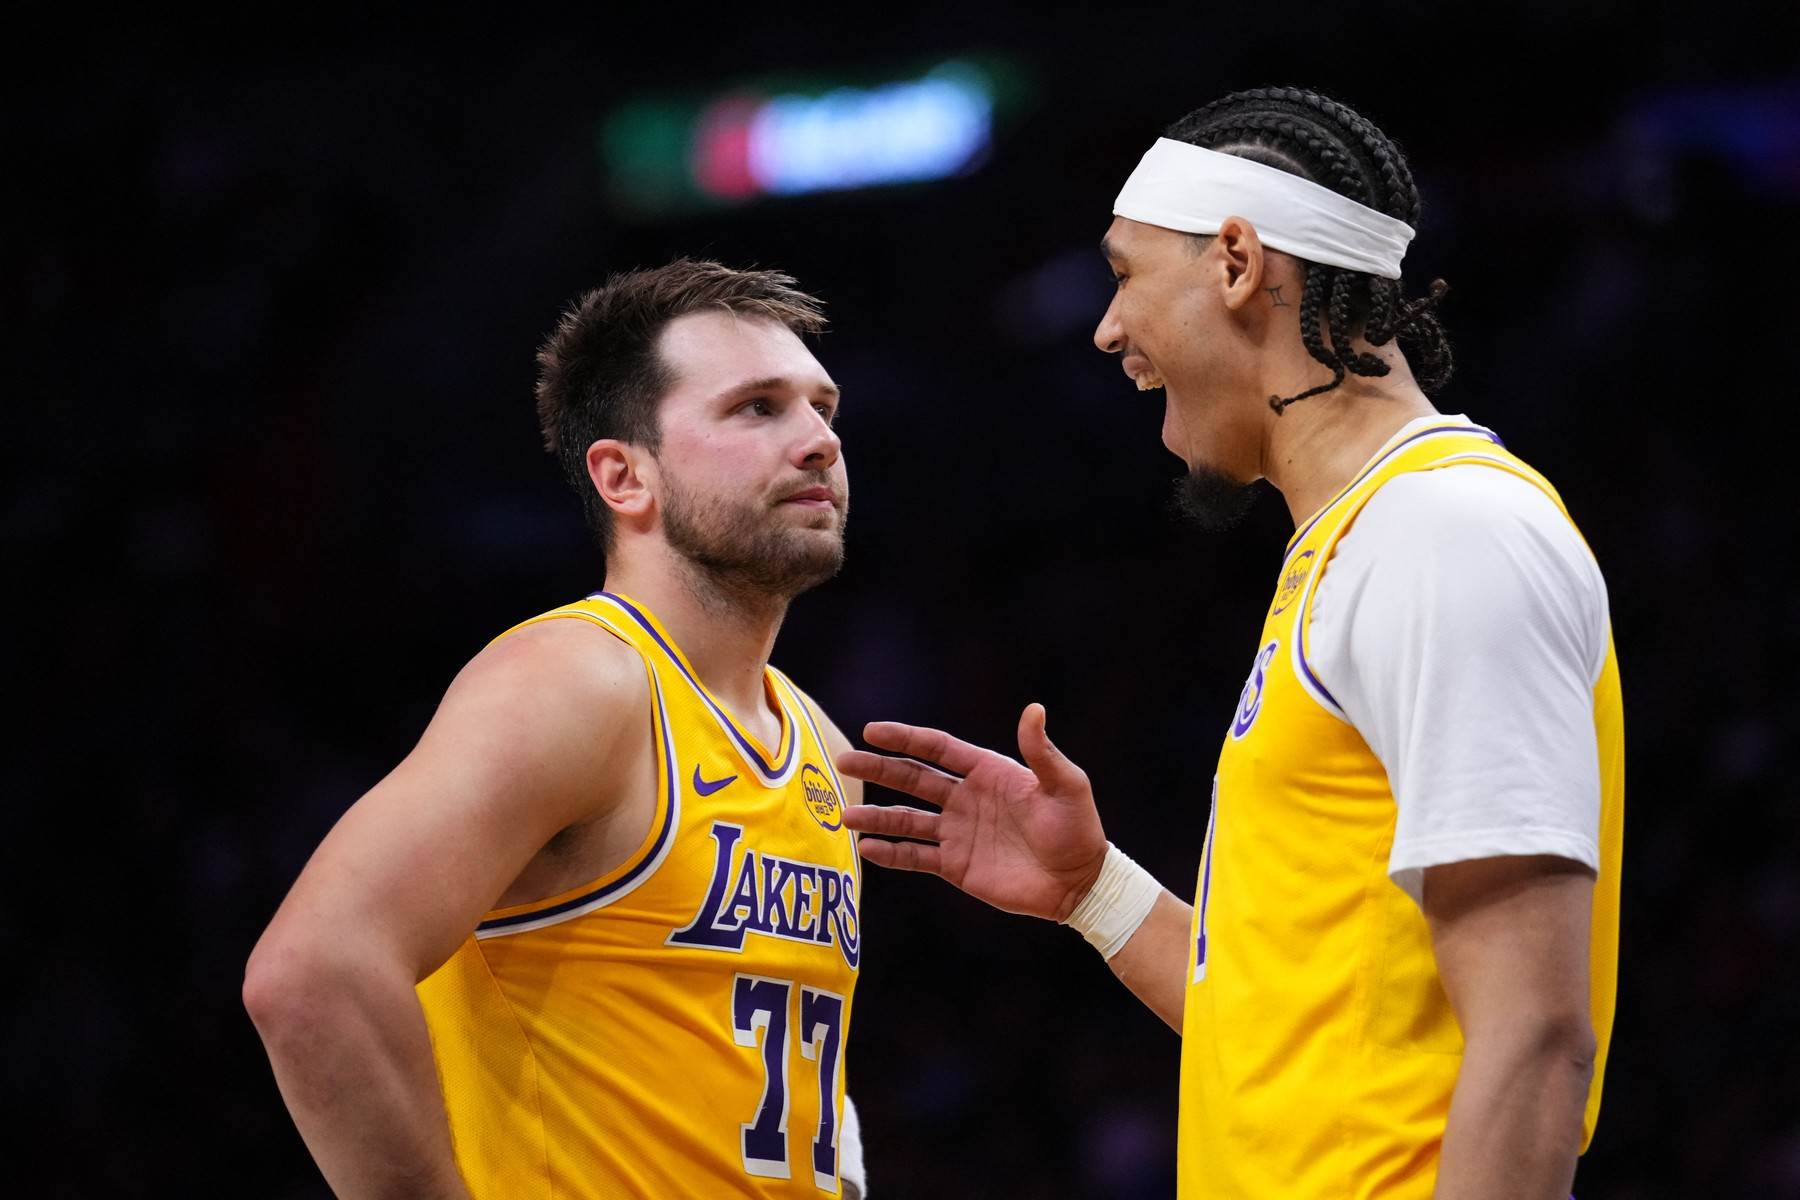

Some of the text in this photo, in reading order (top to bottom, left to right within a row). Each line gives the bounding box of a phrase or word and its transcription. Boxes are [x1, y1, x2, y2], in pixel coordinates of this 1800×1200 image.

[803, 780, 837, 812] bibigo
[664, 820, 860, 971] LAKERS
[731, 972, 846, 1194] 77
